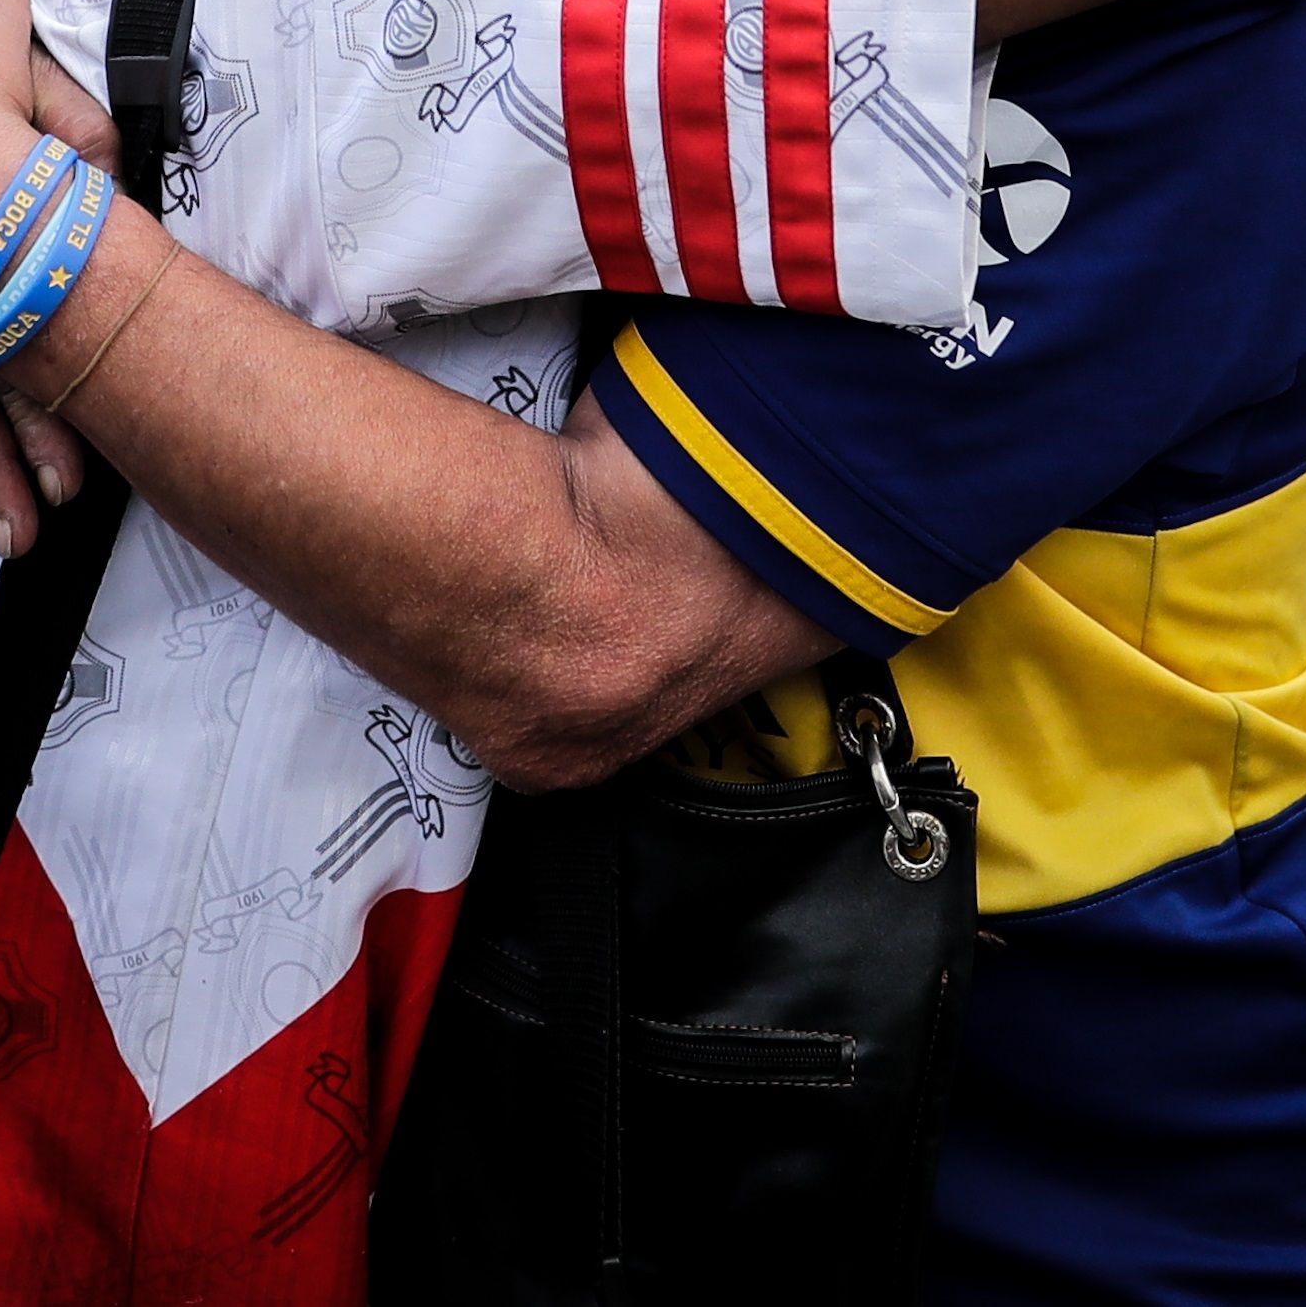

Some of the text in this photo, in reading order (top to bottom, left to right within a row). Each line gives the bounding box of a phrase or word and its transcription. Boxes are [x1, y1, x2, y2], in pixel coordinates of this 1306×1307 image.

[468, 70, 495, 98] 1901
[830, 91, 859, 120] 1901
[25, 161, 55, 190] DE
[67, 220, 92, 251] EL
[210, 597, 240, 617] 1901
[237, 888, 266, 909] 1901
[121, 951, 149, 969] 1901
